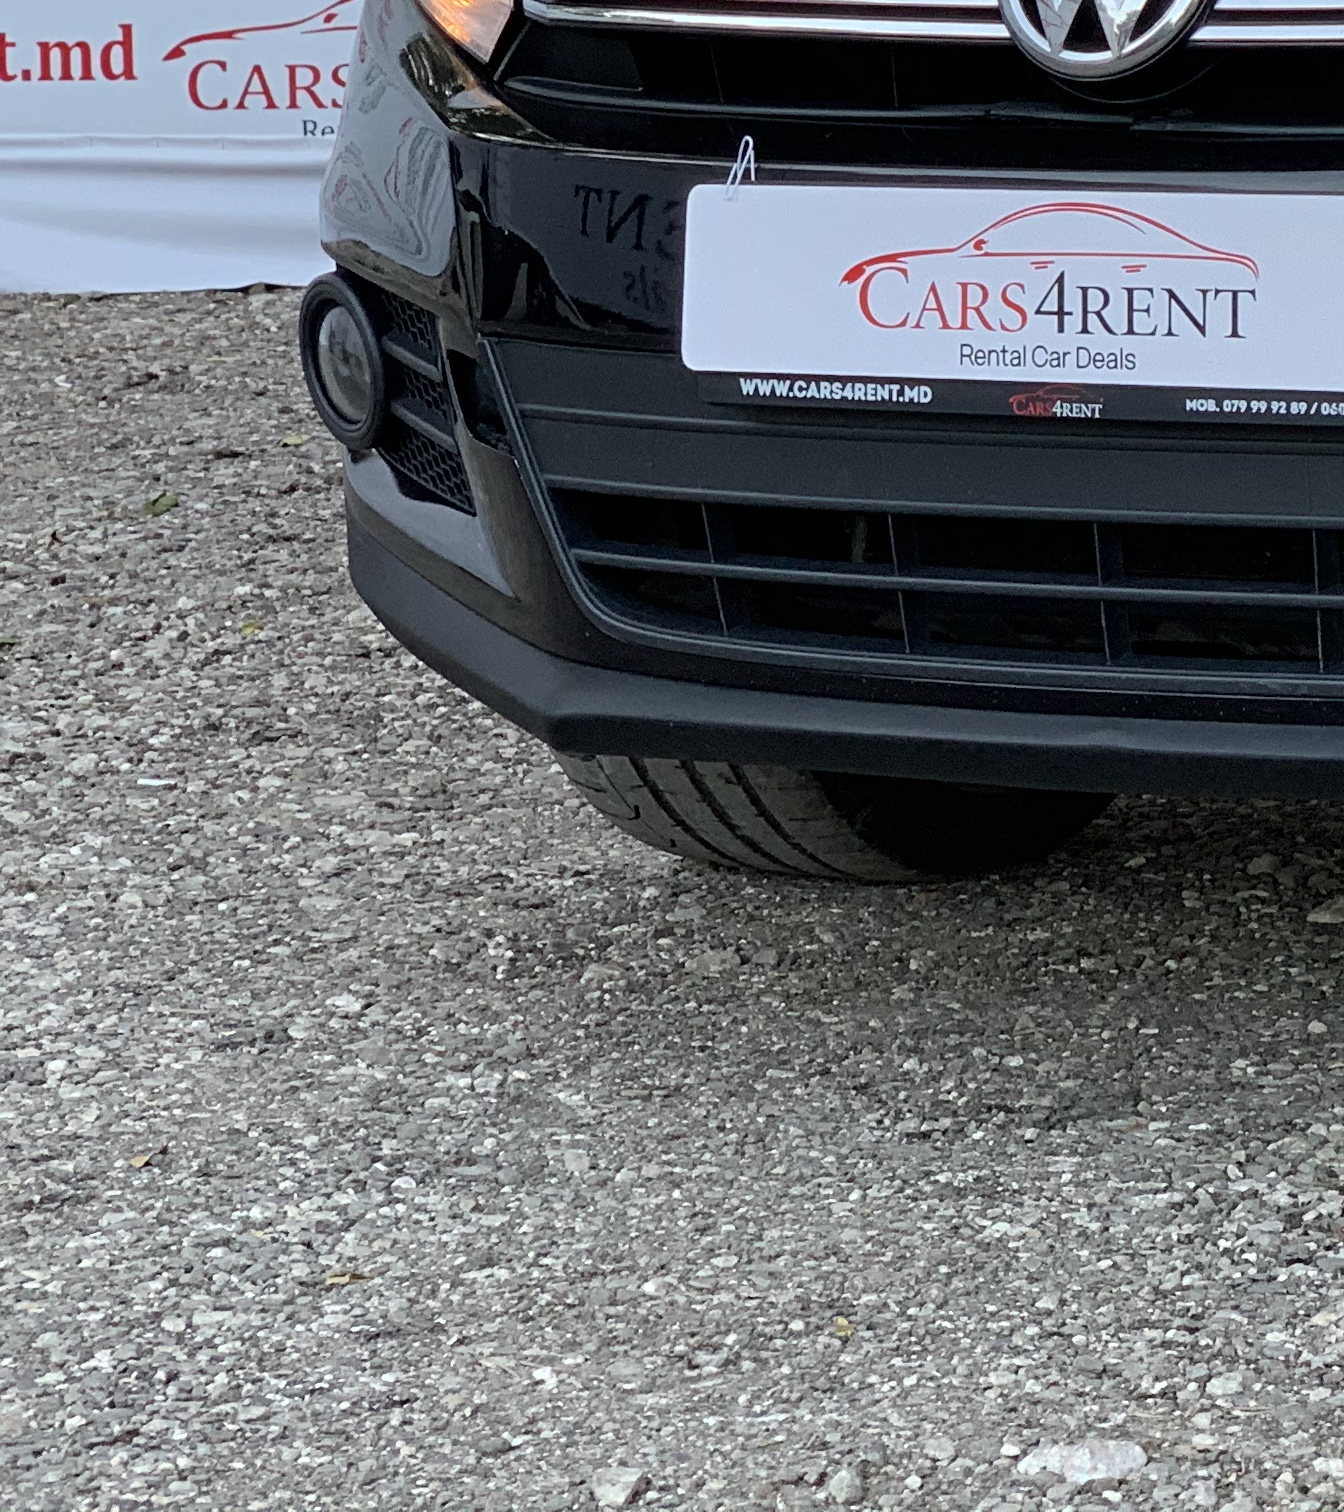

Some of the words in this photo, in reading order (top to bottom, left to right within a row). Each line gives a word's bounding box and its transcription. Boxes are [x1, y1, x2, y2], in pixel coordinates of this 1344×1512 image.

[858, 267, 1257, 338] CARS4RENT
[960, 344, 1026, 367] Rental
[1032, 345, 1071, 368] Car
[1077, 347, 1136, 370] Deals
[739, 377, 933, 404] WWW.CARS4RENT.MD
[1011, 398, 1102, 418] CARS4RENT
[1186, 399, 1220, 413] MOB.
[1222, 399, 1248, 414] 079
[1250, 400, 1268, 414] 99
[1270, 400, 1287, 414] 92
[1289, 401, 1308, 415] 89
[1309, 401, 1318, 415] /
